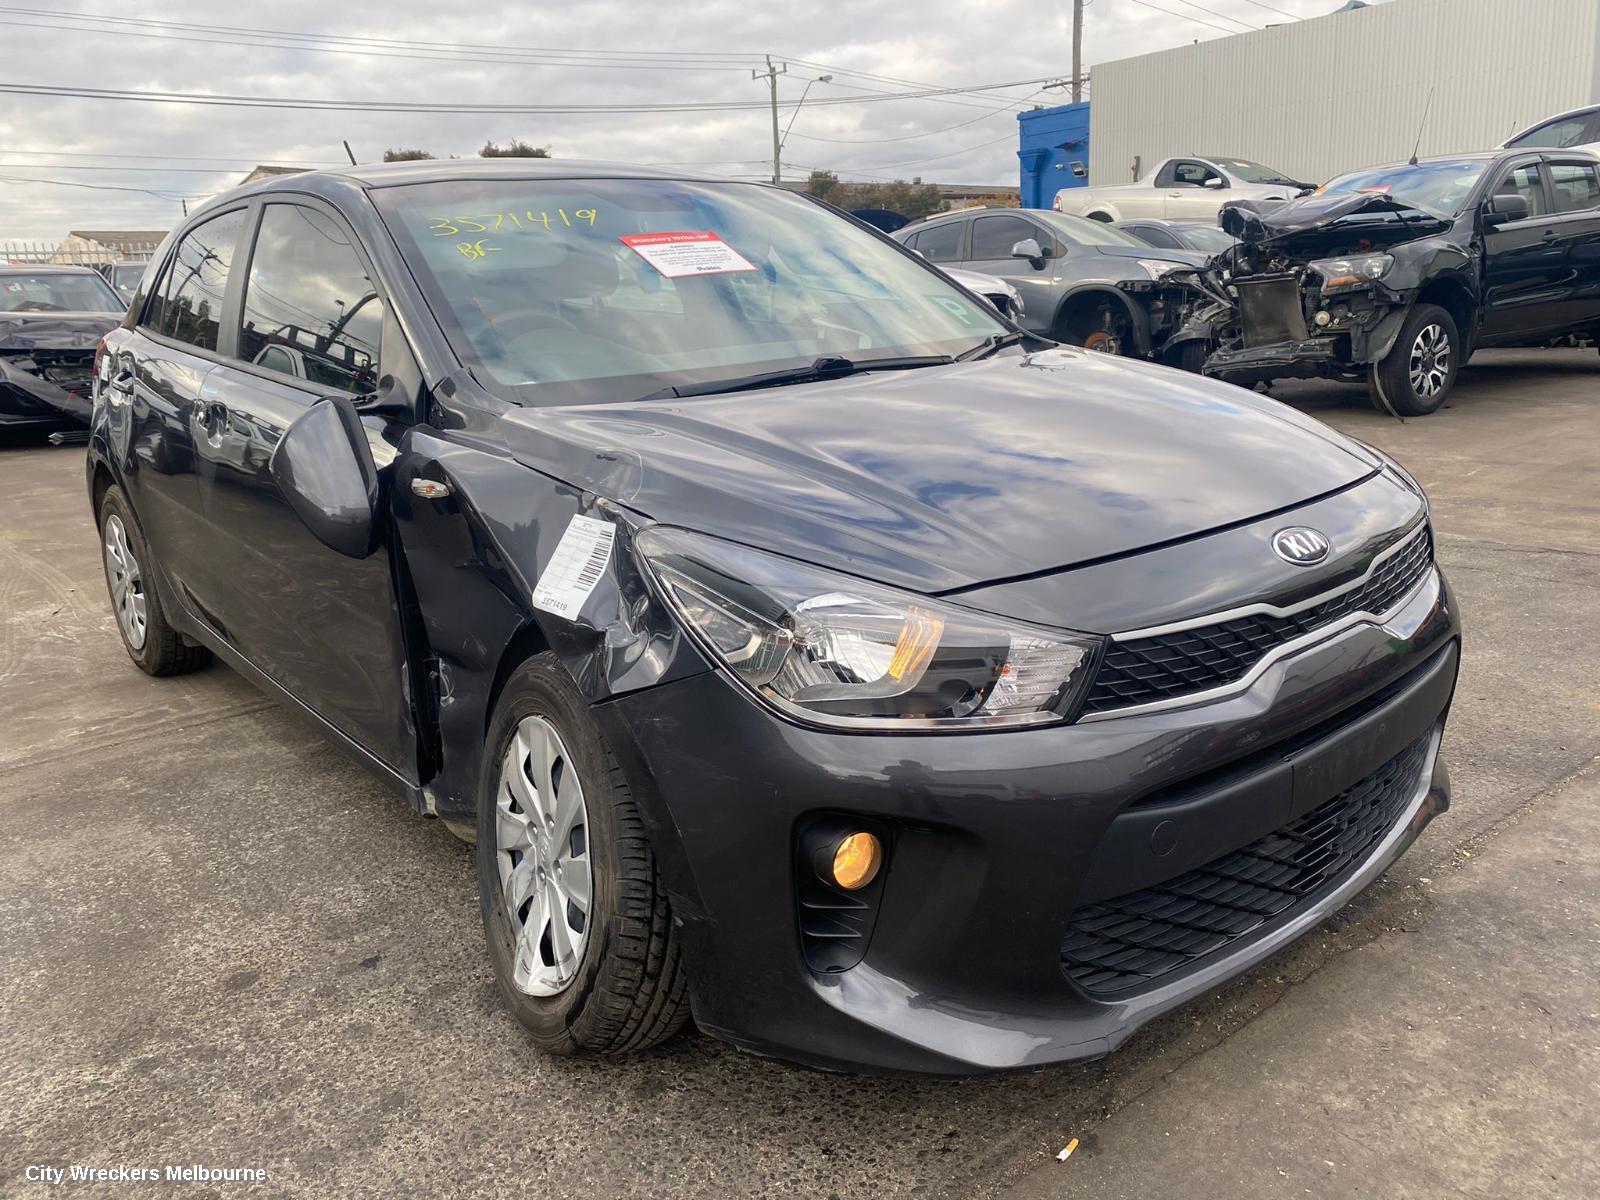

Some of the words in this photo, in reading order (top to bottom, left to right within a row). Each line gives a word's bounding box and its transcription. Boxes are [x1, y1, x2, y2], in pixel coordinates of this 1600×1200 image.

[429, 208, 597, 237] 3571419
[1280, 530, 1328, 558] KIA
[541, 597, 568, 611] 3571419
